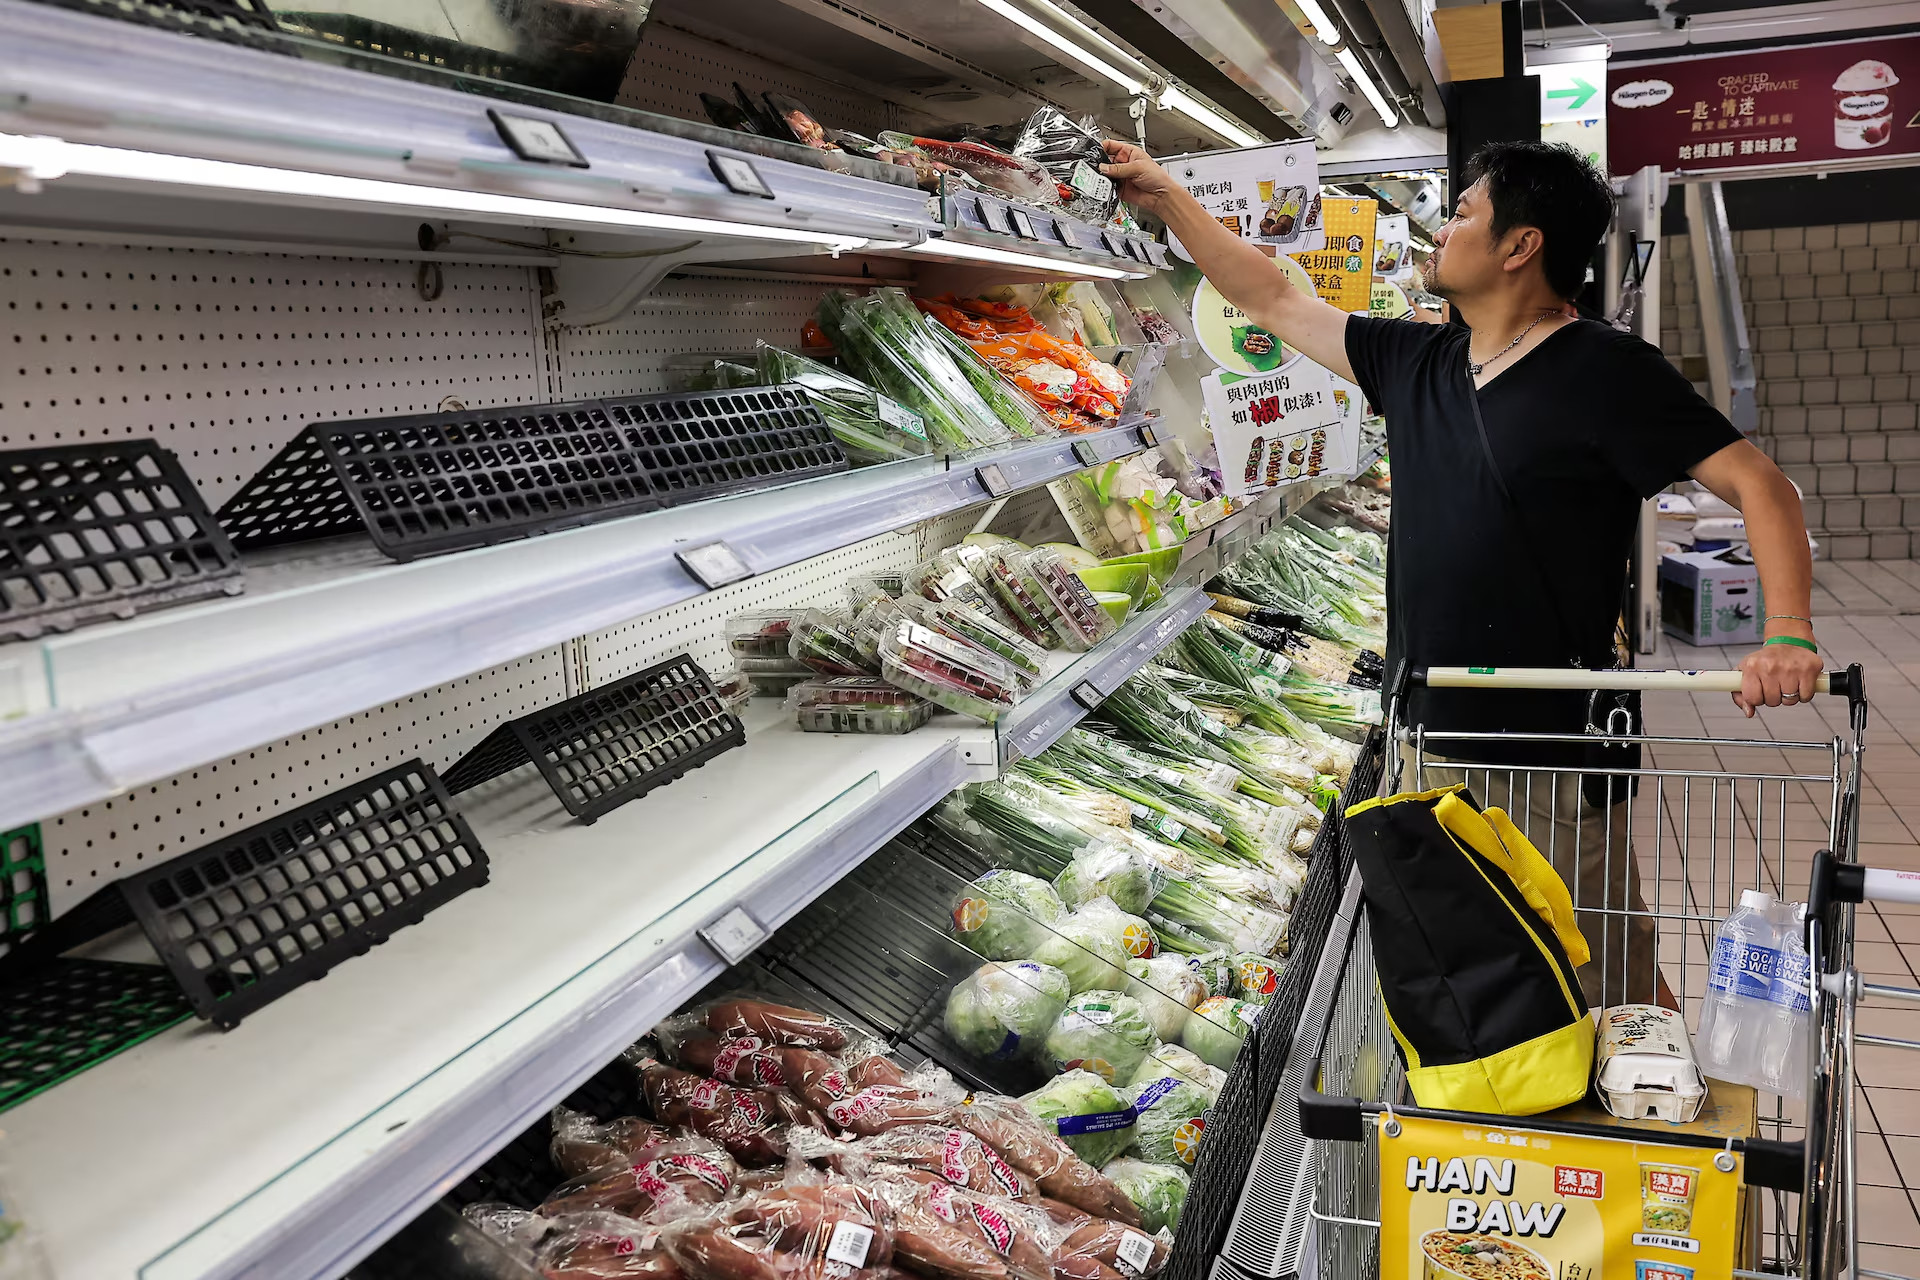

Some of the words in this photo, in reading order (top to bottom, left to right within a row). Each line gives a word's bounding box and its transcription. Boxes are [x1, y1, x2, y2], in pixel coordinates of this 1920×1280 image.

[1718, 72, 1769, 88] CRAFTED
[1724, 85, 1739, 95] TO
[1741, 79, 1799, 95] CAPTIVATE
[1298, 254, 1362, 272] 免切即煮
[1308, 274, 1343, 290] 菜盒
[1227, 375, 1290, 404] 與肉肉的
[1406, 1156, 1515, 1196] HAN
[1558, 1169, 1599, 1188] 漢寶
[1558, 1185, 1576, 1194] HAN
[1578, 1187, 1597, 1195] BAW
[1652, 1184, 1669, 1192] HAN
[1669, 1187, 1685, 1195] BAW
[1446, 1198, 1566, 1238] BAW
